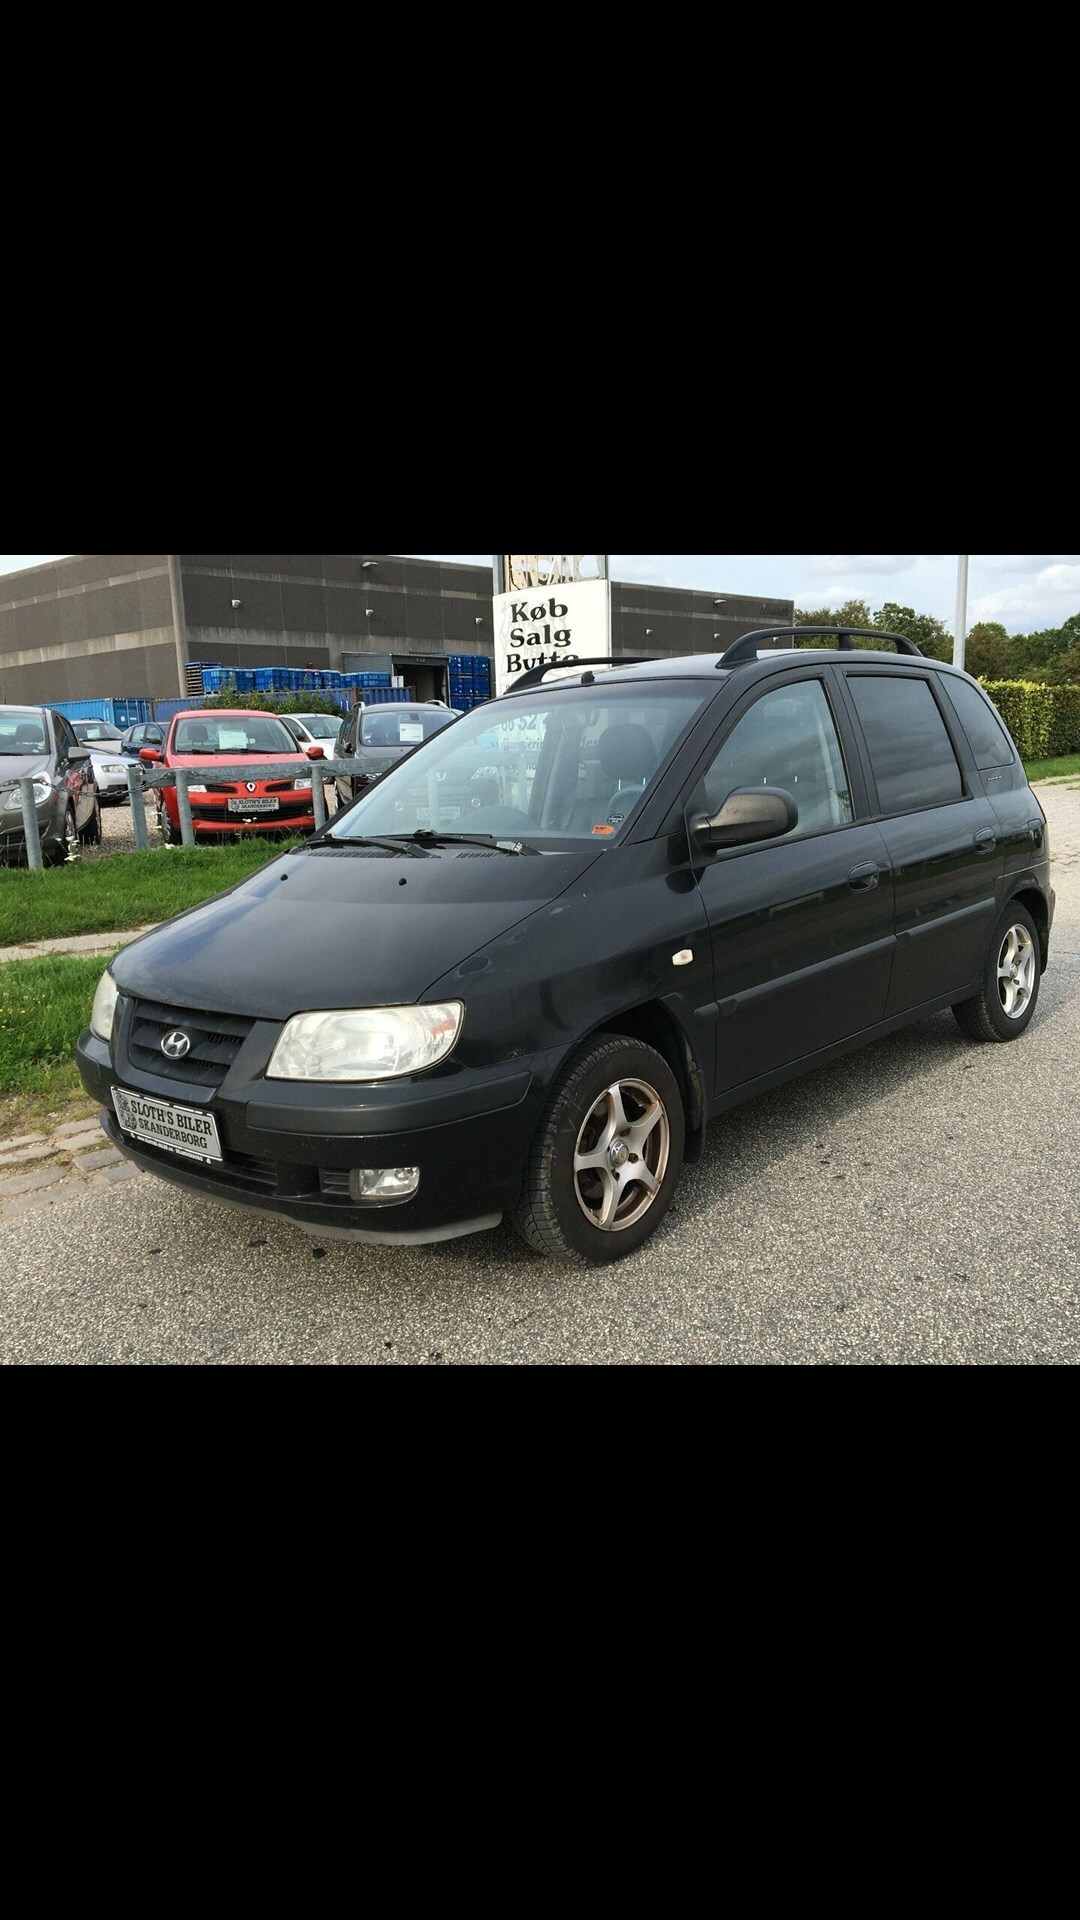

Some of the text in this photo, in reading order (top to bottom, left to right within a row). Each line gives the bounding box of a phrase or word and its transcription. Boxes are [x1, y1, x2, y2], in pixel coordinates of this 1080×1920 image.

[510, 597, 568, 623] Køb
[510, 624, 571, 647] Salg
[131, 1100, 213, 1135] SLOTH'S BILER
[138, 1118, 208, 1149] SKANDERBORG
